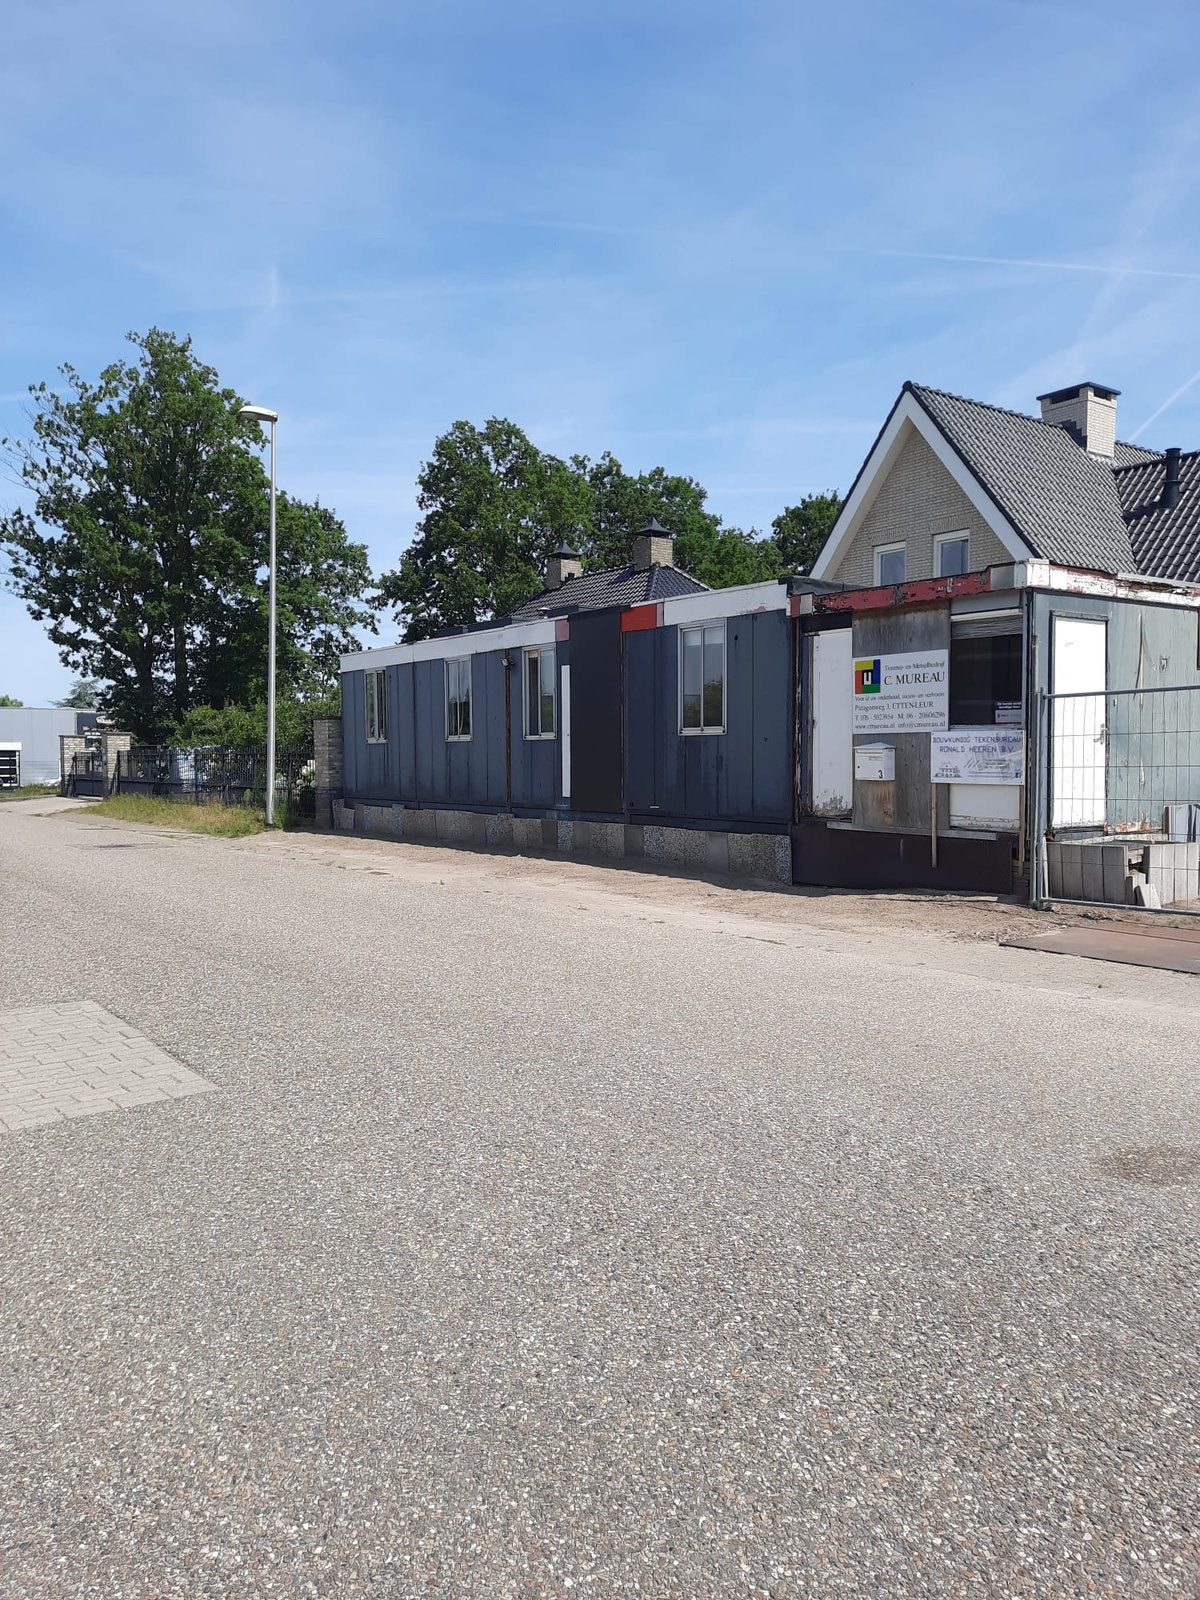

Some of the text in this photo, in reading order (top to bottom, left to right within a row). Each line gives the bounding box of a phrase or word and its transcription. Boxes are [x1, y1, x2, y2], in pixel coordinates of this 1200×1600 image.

[884, 672, 945, 685] C. MUREAU
[893, 701, 935, 710] ETTEN-LEUR
[878, 770, 883, 779] 3
